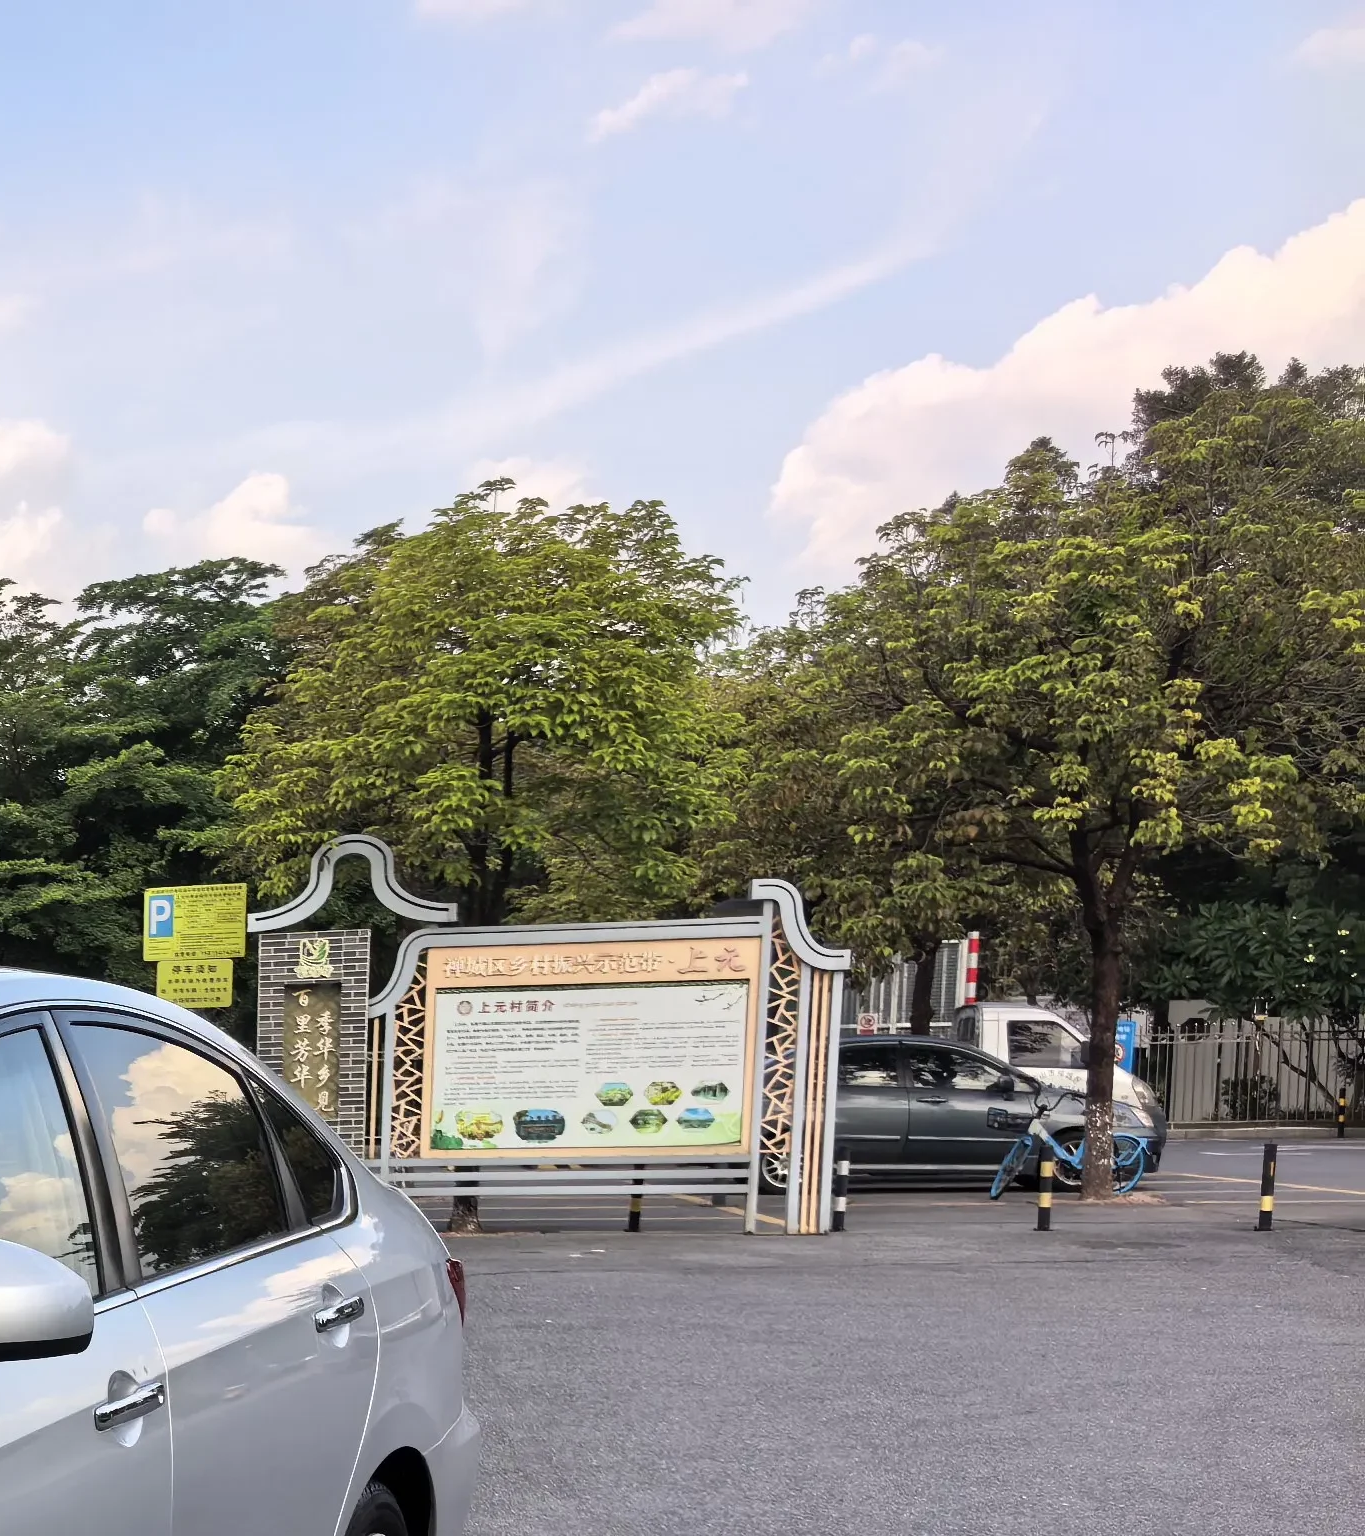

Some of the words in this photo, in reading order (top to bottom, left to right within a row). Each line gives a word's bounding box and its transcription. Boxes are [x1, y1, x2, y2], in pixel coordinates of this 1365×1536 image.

[290, 989, 313, 1089] 百里芳华
[478, 1000, 555, 1014] 上元村简介
[313, 1010, 337, 1111] 季华乡见
